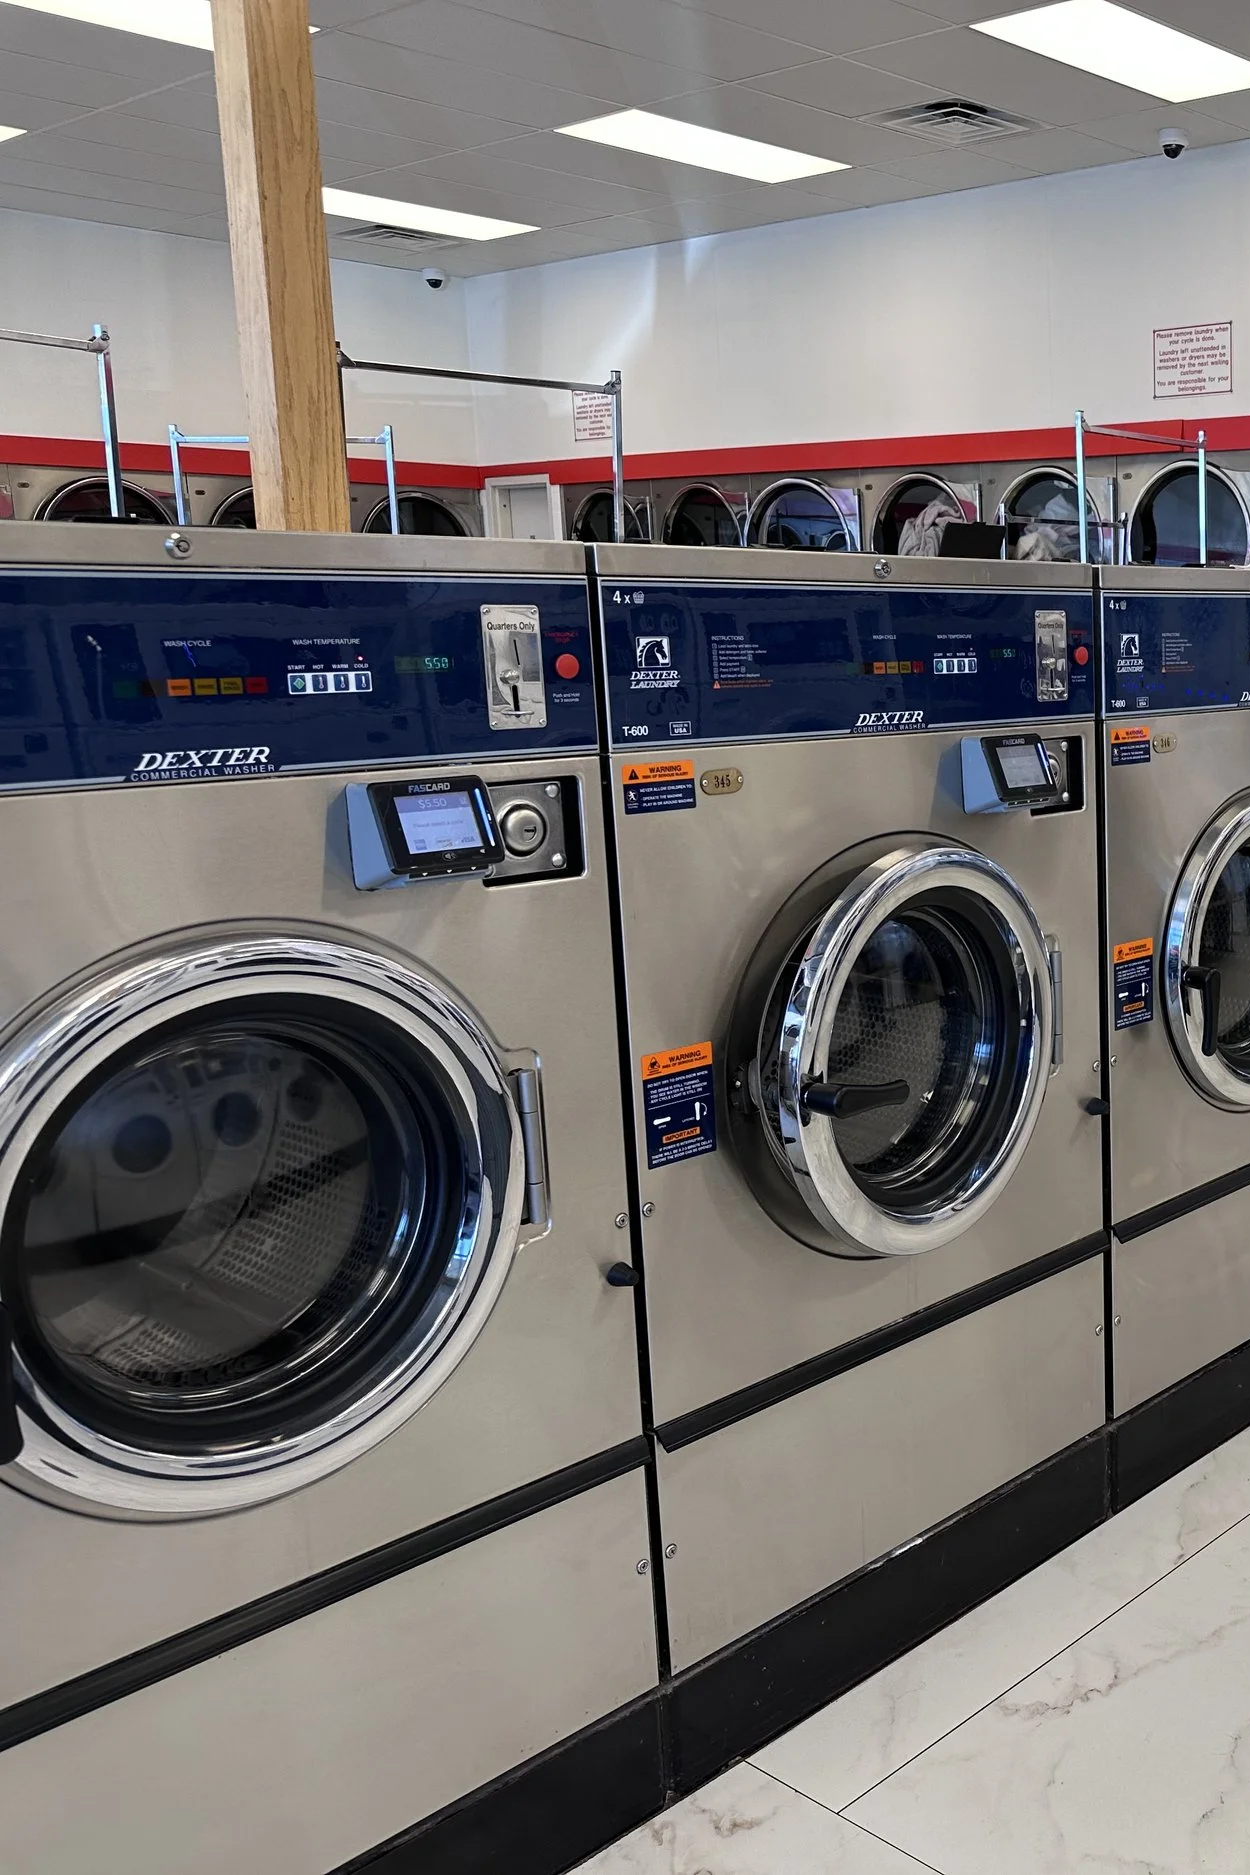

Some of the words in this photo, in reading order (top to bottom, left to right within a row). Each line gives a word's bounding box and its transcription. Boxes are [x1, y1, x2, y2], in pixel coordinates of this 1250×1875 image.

[1191, 345, 1219, 353] unattended
[1177, 377, 1206, 385] responsible
[613, 591, 621, 603] 4
[624, 595, 630, 603] x
[1109, 600, 1114, 610] 4
[487, 622, 517, 631] Quarters
[519, 622, 535, 631] Only
[630, 671, 678, 680] DEXTER
[630, 680, 680, 688] LAUNDRY
[856, 711, 923, 726] DEXTER
[622, 726, 648, 736] T-600
[853, 724, 897, 733] COMMERCIAL
[134, 746, 270, 771] DEXTER
[131, 768, 218, 782] COMMERCIAL
[224, 764, 275, 774] WASHER
[649, 765, 681, 773] WARNING
[714, 775, 730, 788] 345
[408, 783, 450, 793] FASCARD
[418, 798, 447, 809] $5.50
[668, 1050, 701, 1063] WARNING
[665, 1129, 697, 1141] IMPORTANT
